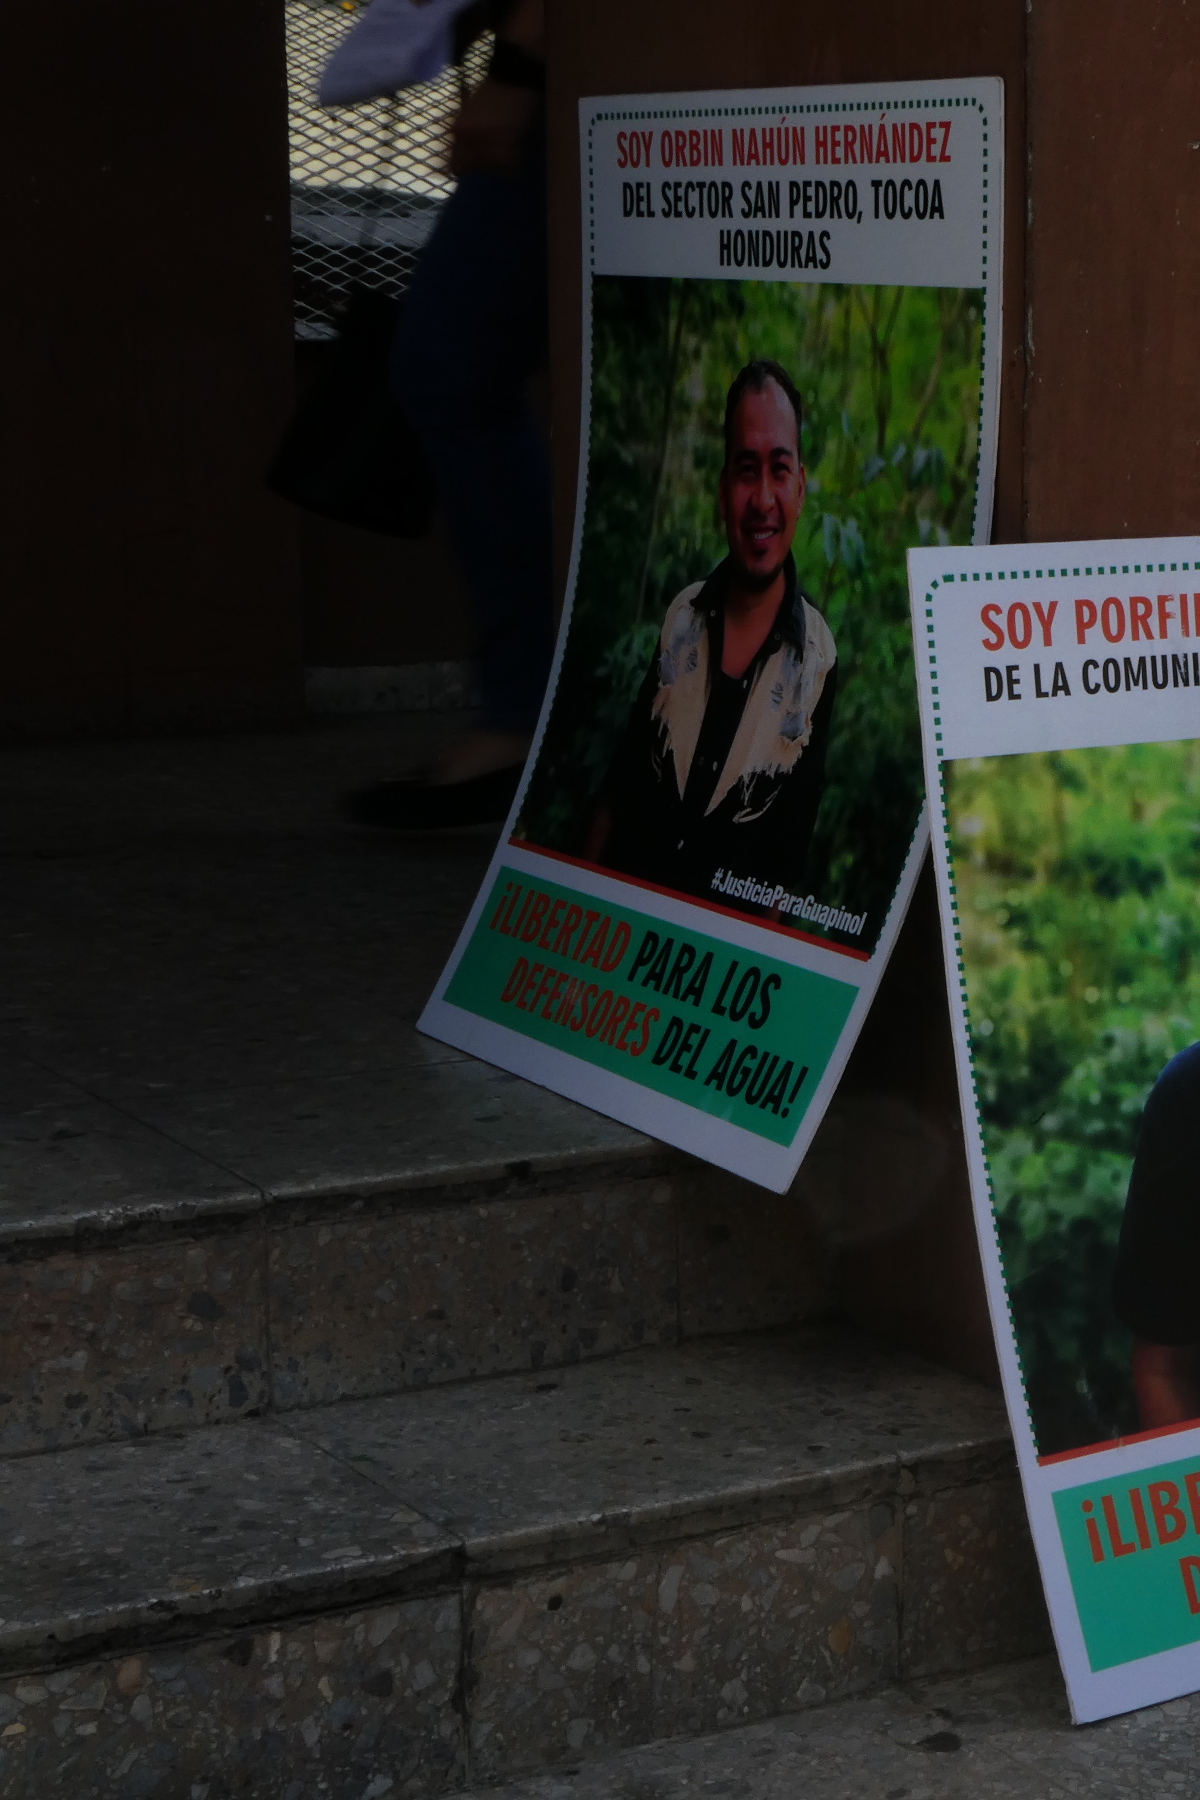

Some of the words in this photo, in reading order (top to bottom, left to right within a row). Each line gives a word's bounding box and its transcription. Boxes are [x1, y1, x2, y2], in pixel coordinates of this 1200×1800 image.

[617, 130, 654, 168] SOY
[661, 129, 723, 167] ORBIN
[732, 117, 805, 166] NAHÚN
[815, 114, 952, 165] HERNÁNDEZ
[623, 182, 655, 218] DEL
[661, 181, 733, 218] SECTOR
[741, 181, 780, 219] SAN
[789, 180, 862, 223] PEDRO,
[871, 179, 945, 220] TOCOA
[719, 229, 831, 270] HONDURAS
[980, 600, 1058, 652] SOY
[983, 665, 1021, 702] DE
[1033, 661, 1071, 698] LA
[710, 867, 867, 936] #JusticiaParaGuapinol
[489, 881, 633, 973] ¡LIBERTAD
[627, 930, 710, 1008] PARA
[711, 960, 782, 1030] LOS
[500, 956, 661, 1058] DEFENSORES
[651, 1016, 704, 1081] DEL
[705, 1038, 809, 1119] AGUA!
